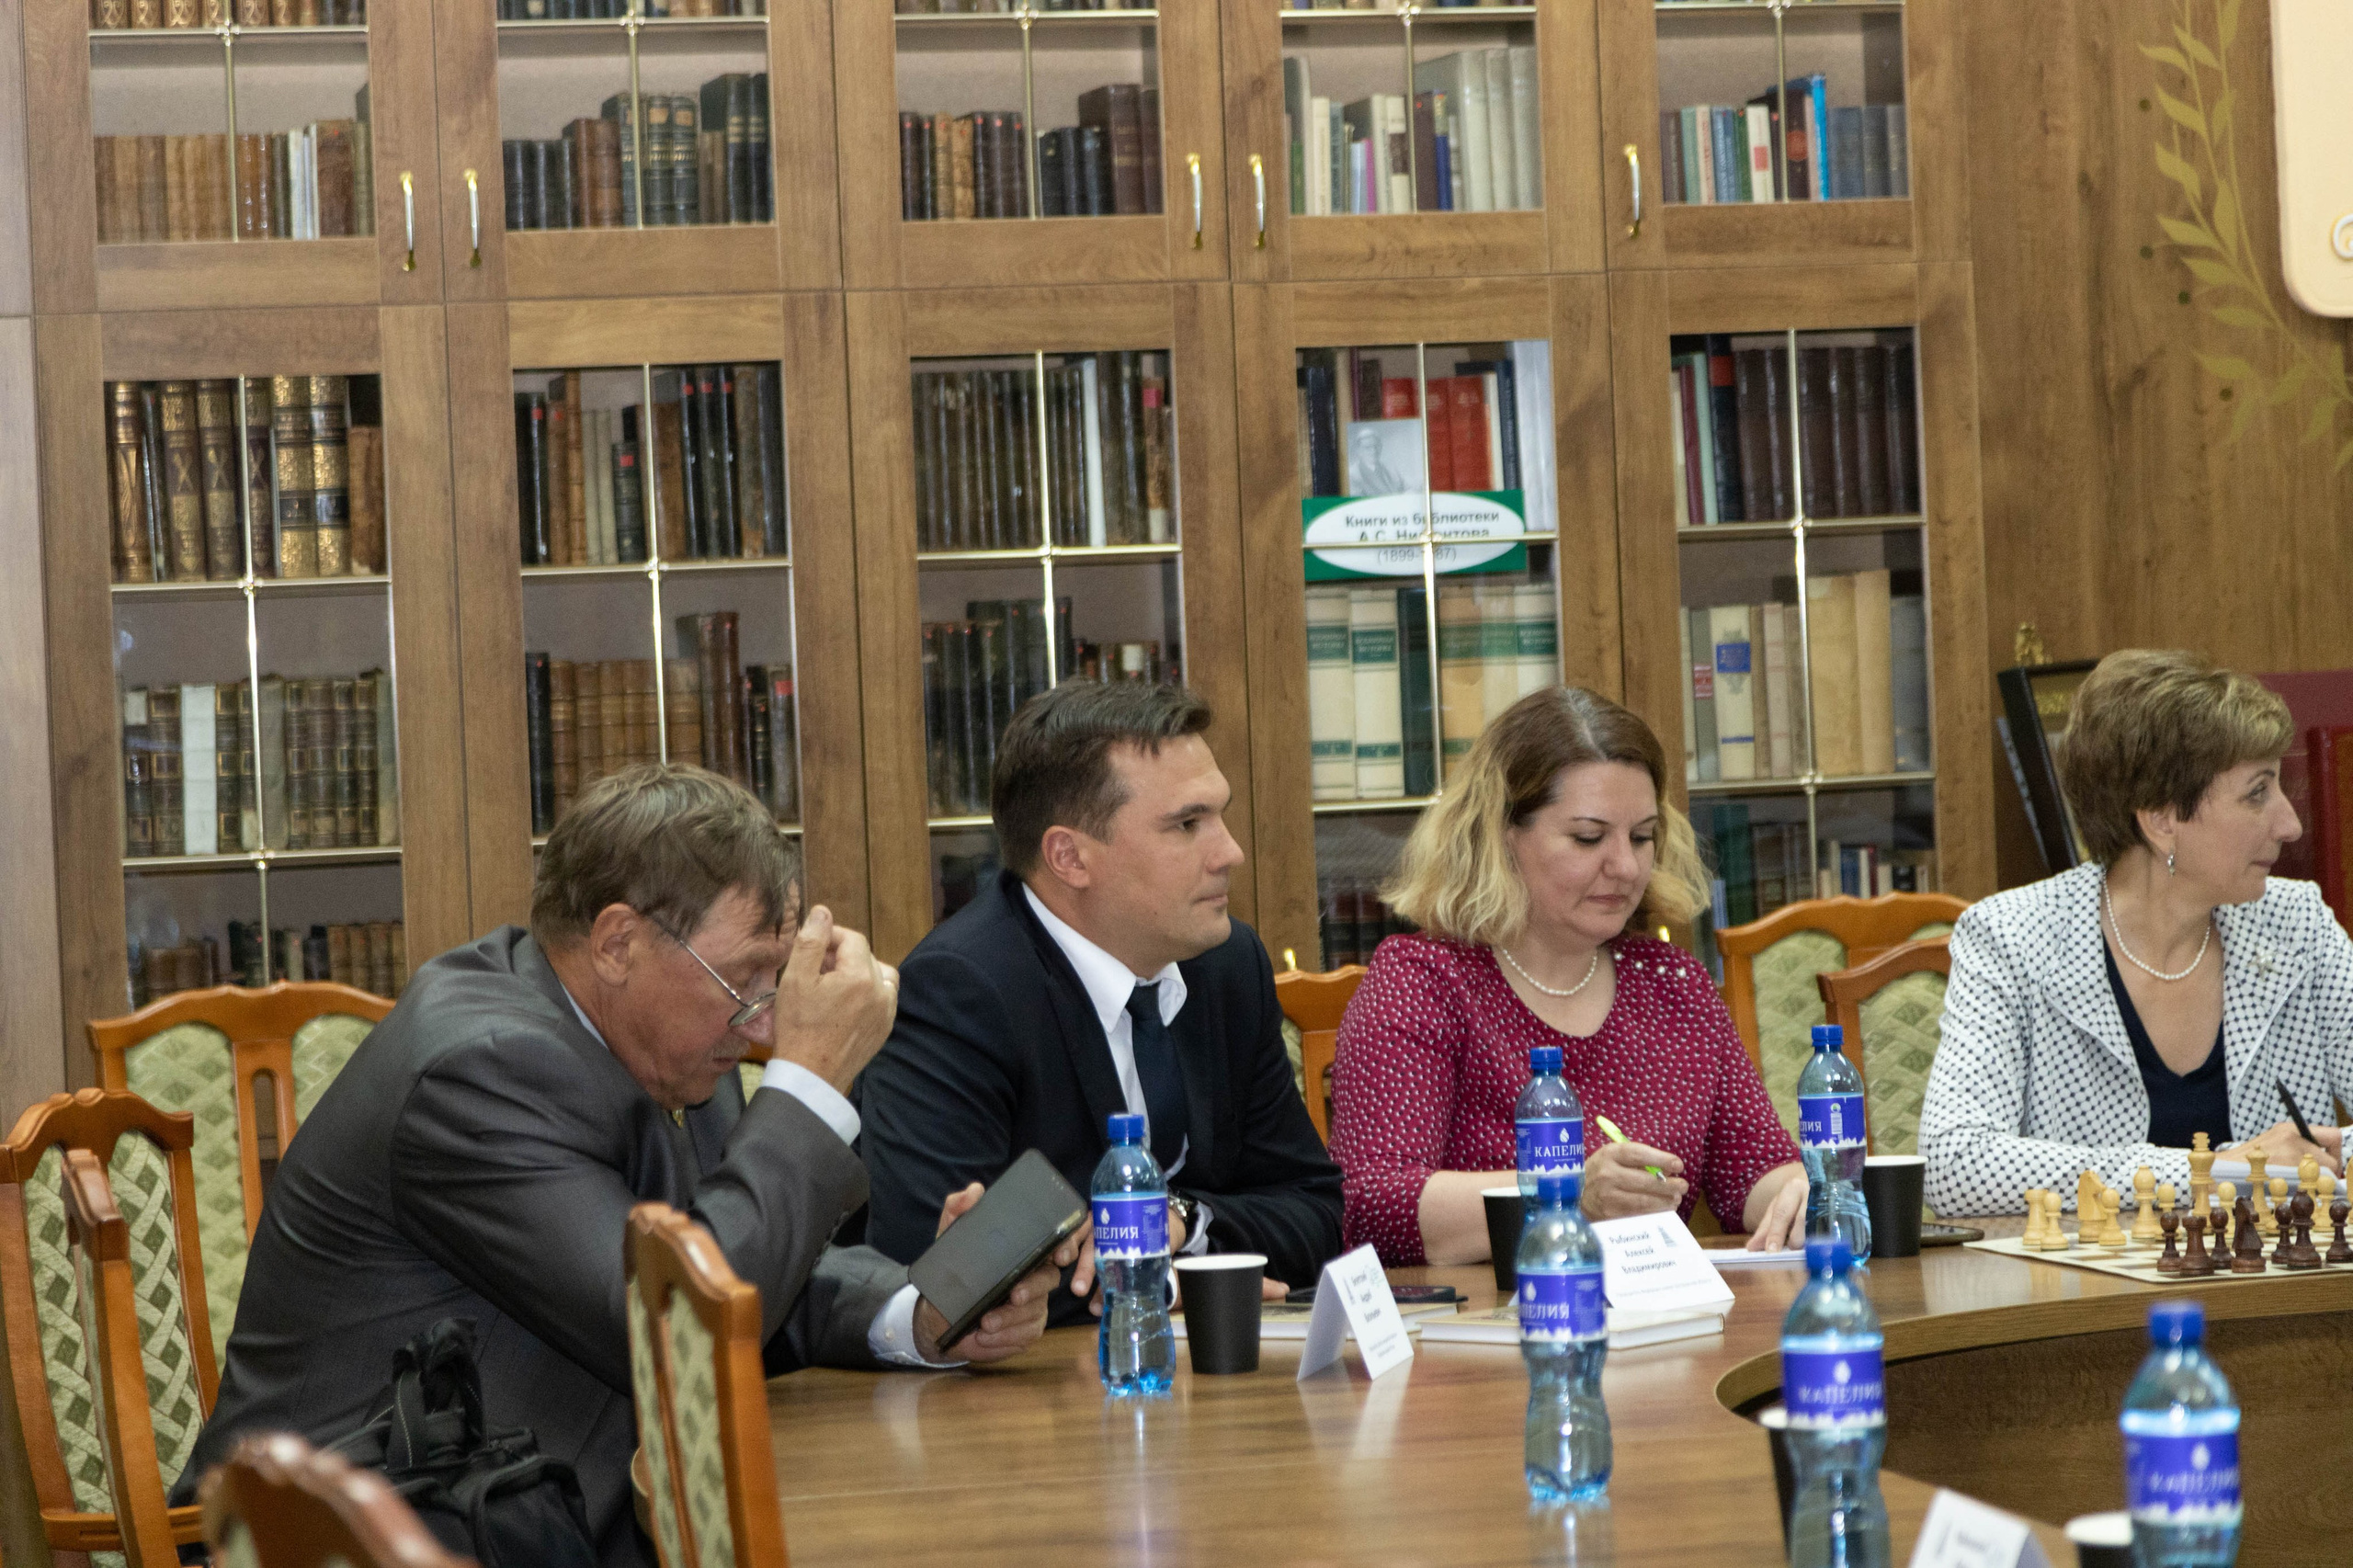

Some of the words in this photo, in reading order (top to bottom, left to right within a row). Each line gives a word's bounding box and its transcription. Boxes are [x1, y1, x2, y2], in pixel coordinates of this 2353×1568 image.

[1346, 515, 1388, 528] Книги
[1392, 516, 1408, 527] из
[1413, 511, 1500, 525] бблиотеки
[1396, 528, 1489, 542] Нинтова
[1377, 546, 1457, 563] (1899-87)
[1094, 1225, 1140, 1241] ПЕЛИЯ
[1621, 1259, 1677, 1276] Владимирович
[1519, 1301, 1570, 1320] ПЕЛИЯ
